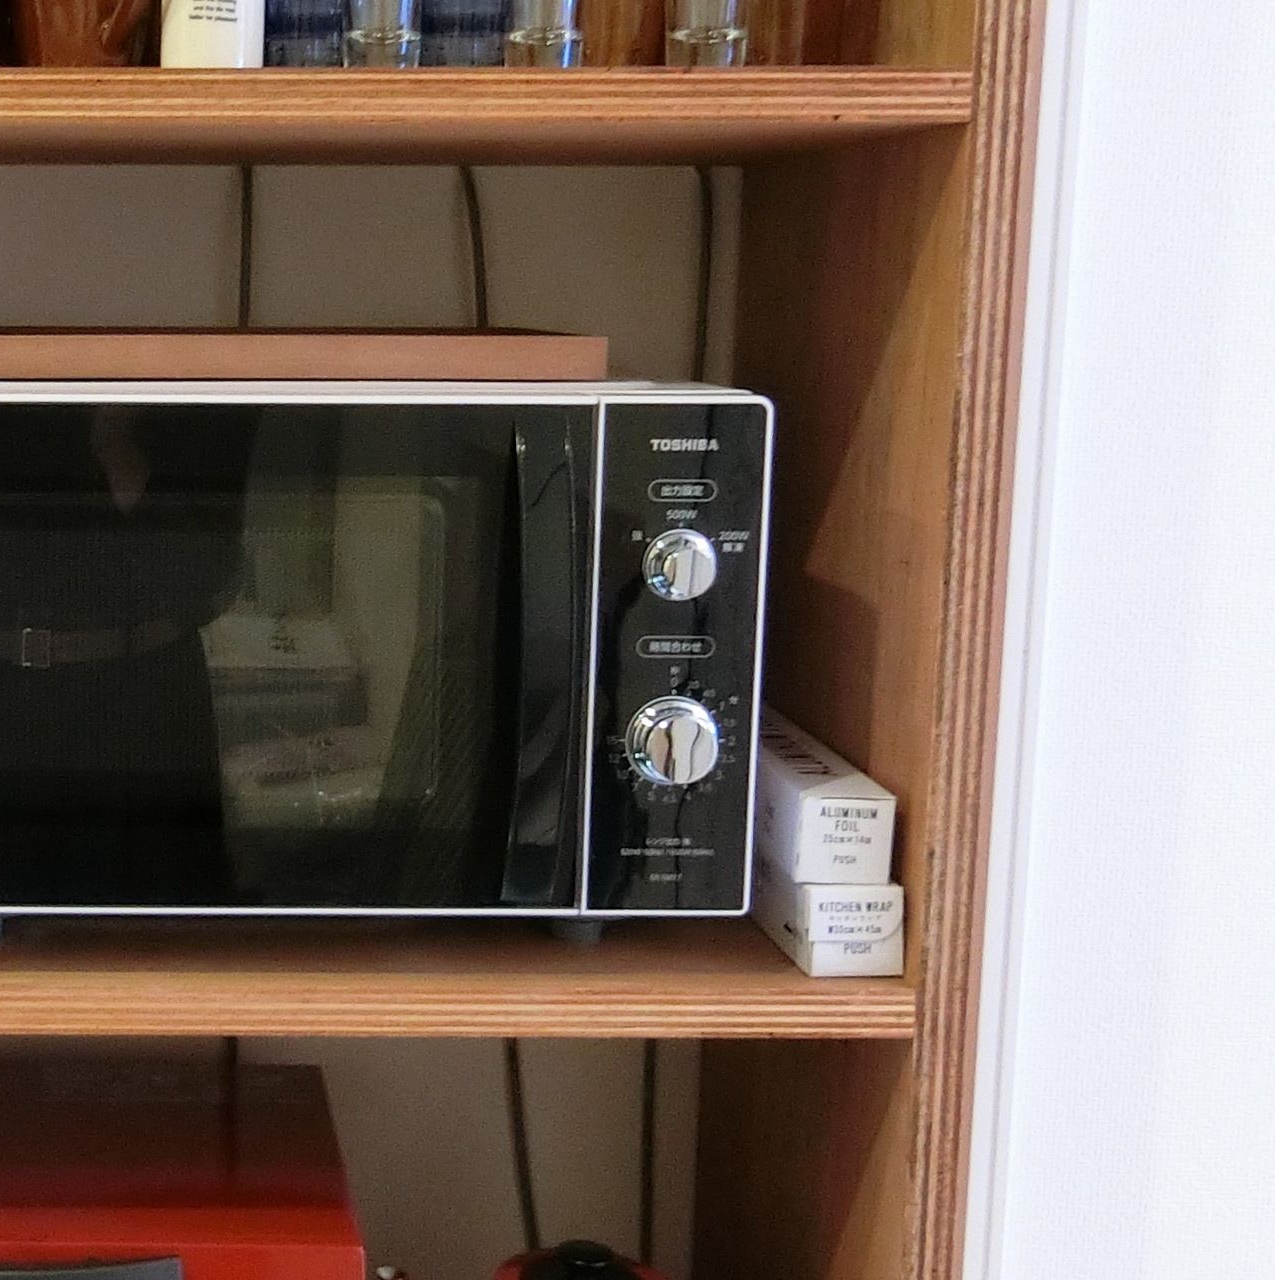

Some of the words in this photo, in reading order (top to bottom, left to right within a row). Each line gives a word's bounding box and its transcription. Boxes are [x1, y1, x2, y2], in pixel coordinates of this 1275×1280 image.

[650, 438, 719, 451] TOSHIBA
[820, 806, 878, 819] ALUMINUM
[835, 820, 860, 832] FOIL
[818, 902, 861, 913] KITCHEN
[865, 900, 893, 912] WRAP
[843, 942, 872, 954] PUSH
